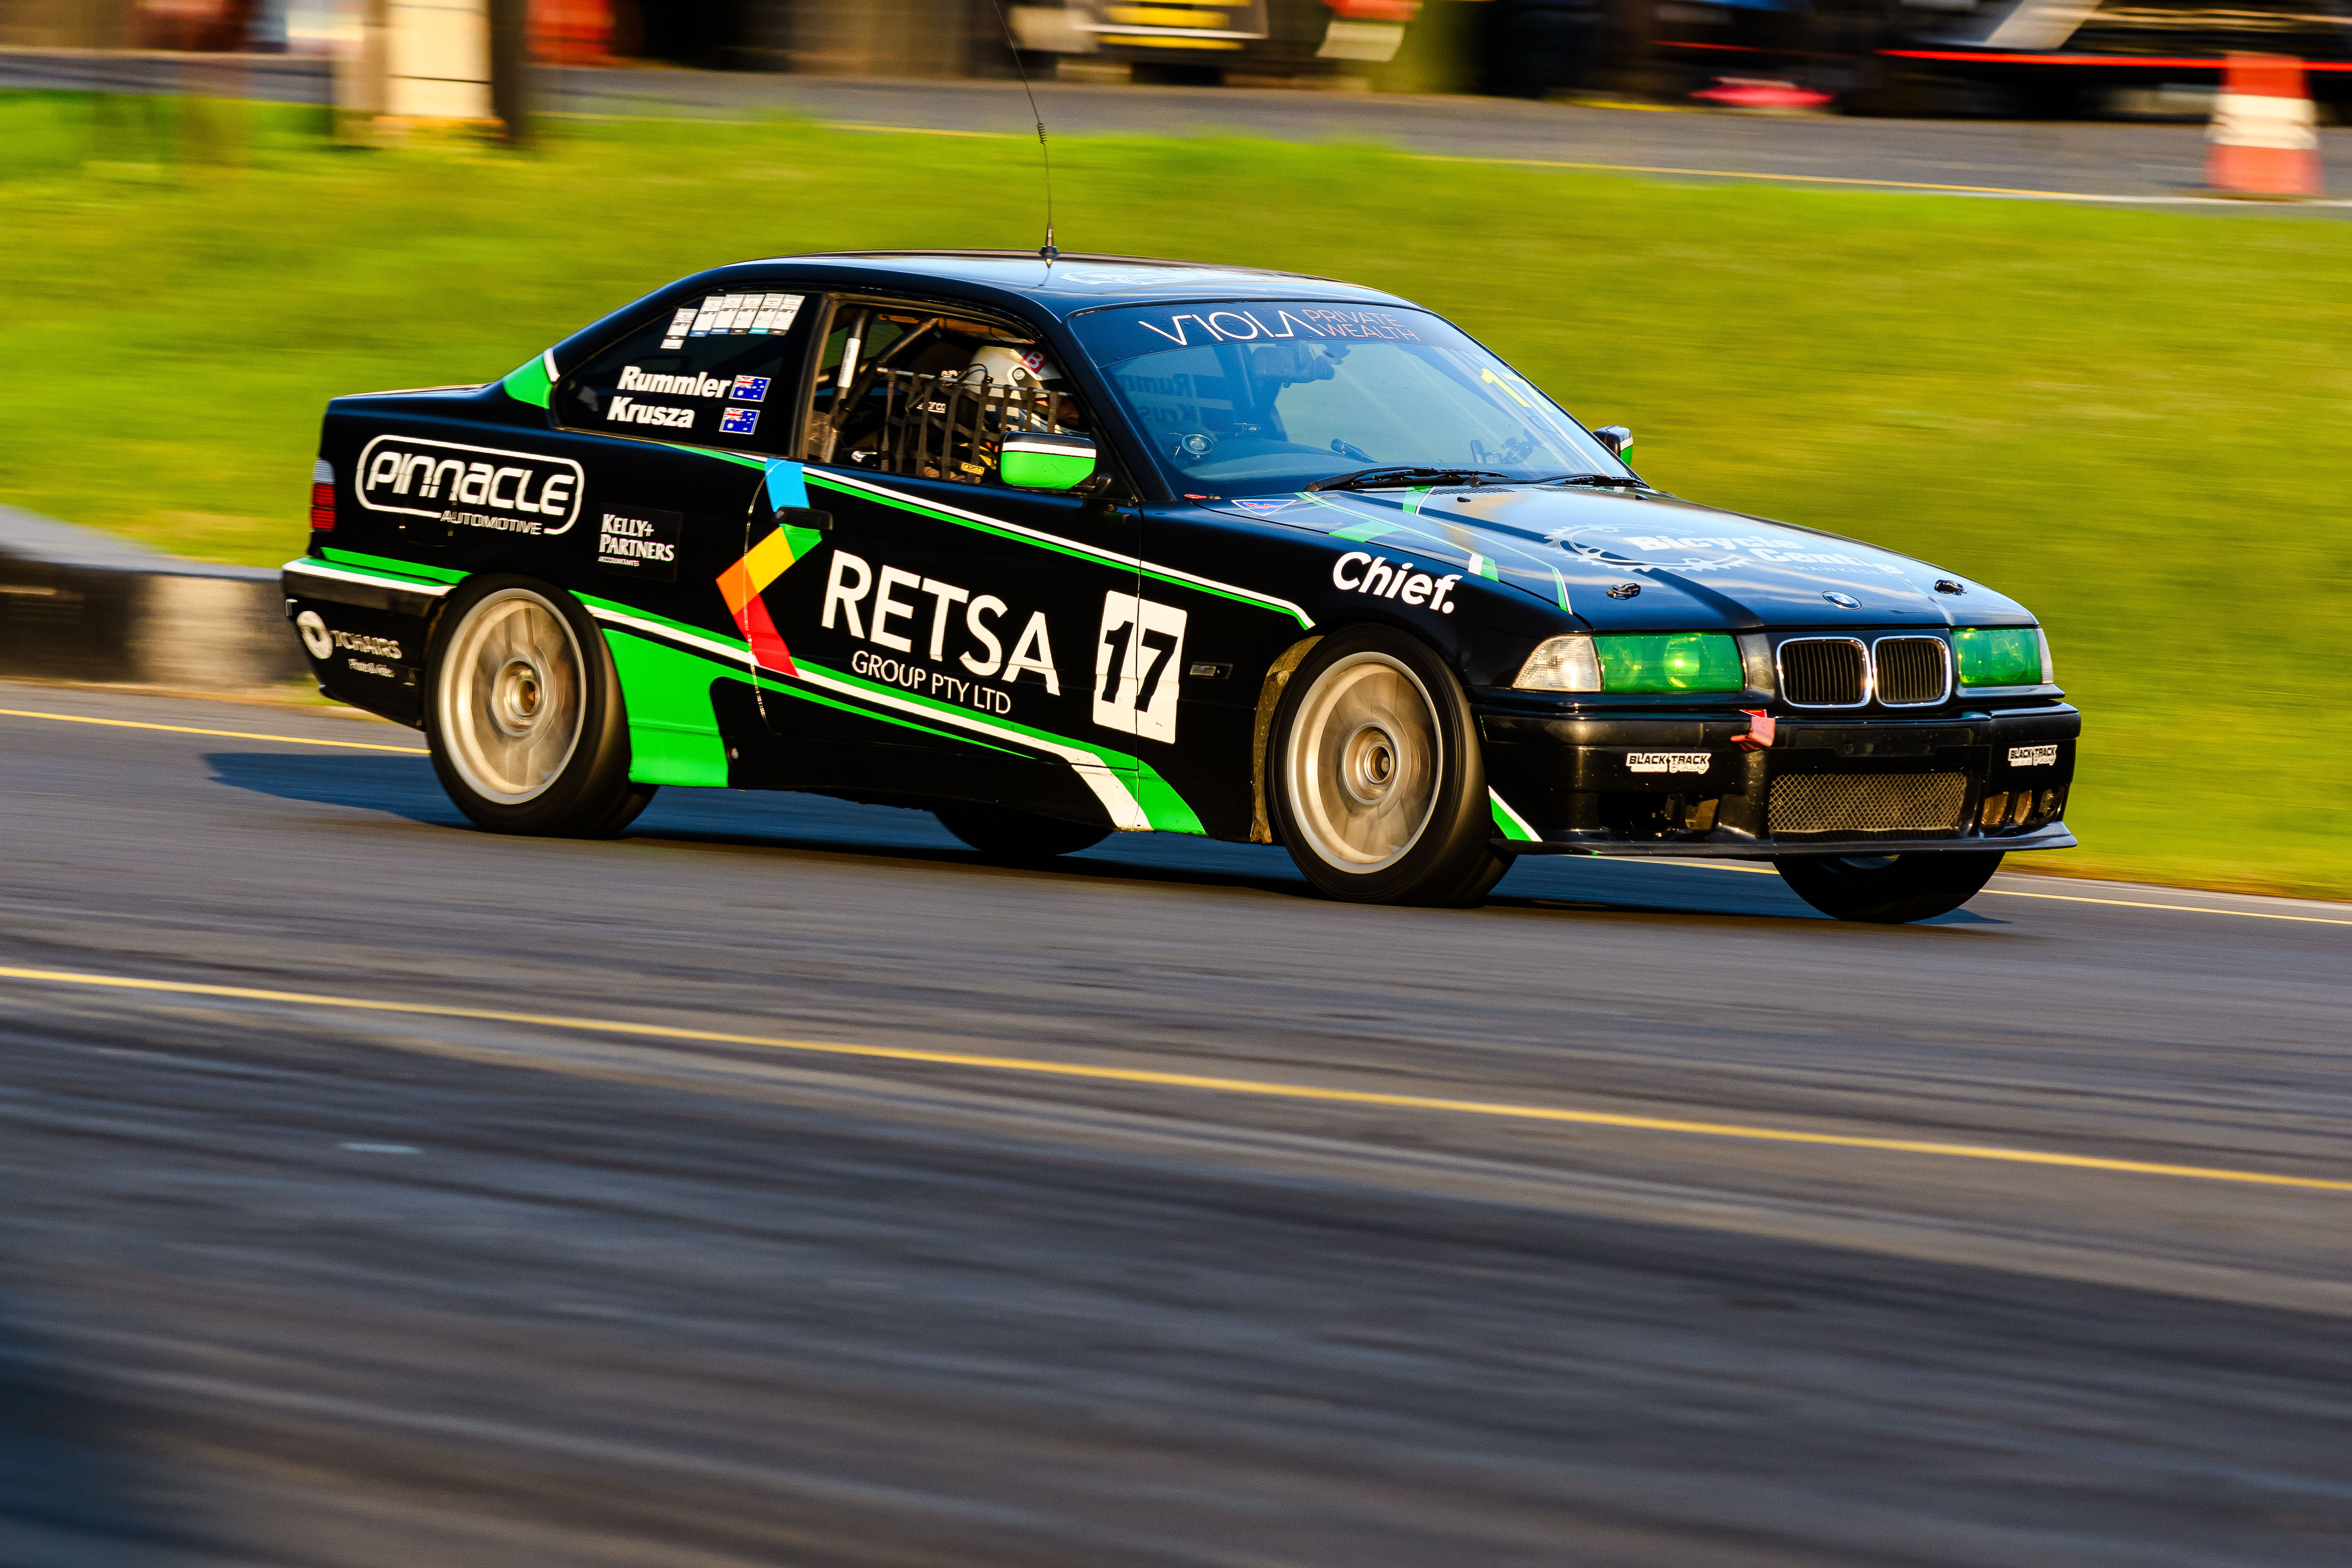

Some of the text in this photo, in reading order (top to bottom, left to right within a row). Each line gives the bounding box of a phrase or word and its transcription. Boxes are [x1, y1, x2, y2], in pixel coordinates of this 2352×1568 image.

[1302, 309, 1404, 327] PRIVATE
[1317, 324, 1421, 341] WEALTH
[617, 366, 732, 398] Rummler
[607, 396, 695, 428] Krusza
[440, 510, 542, 535] AUTOMOTIVE
[599, 534, 674, 561] PARTNERS
[1622, 535, 1806, 551] Bicycle
[1748, 548, 1906, 575] Centre
[1333, 551, 1464, 614] Chief.
[822, 549, 1060, 696] RETSA
[1101, 620, 1178, 713] 17
[852, 650, 1011, 714] GROUP PTY LTD
[1629, 755, 1708, 765] BLACK TRACK
